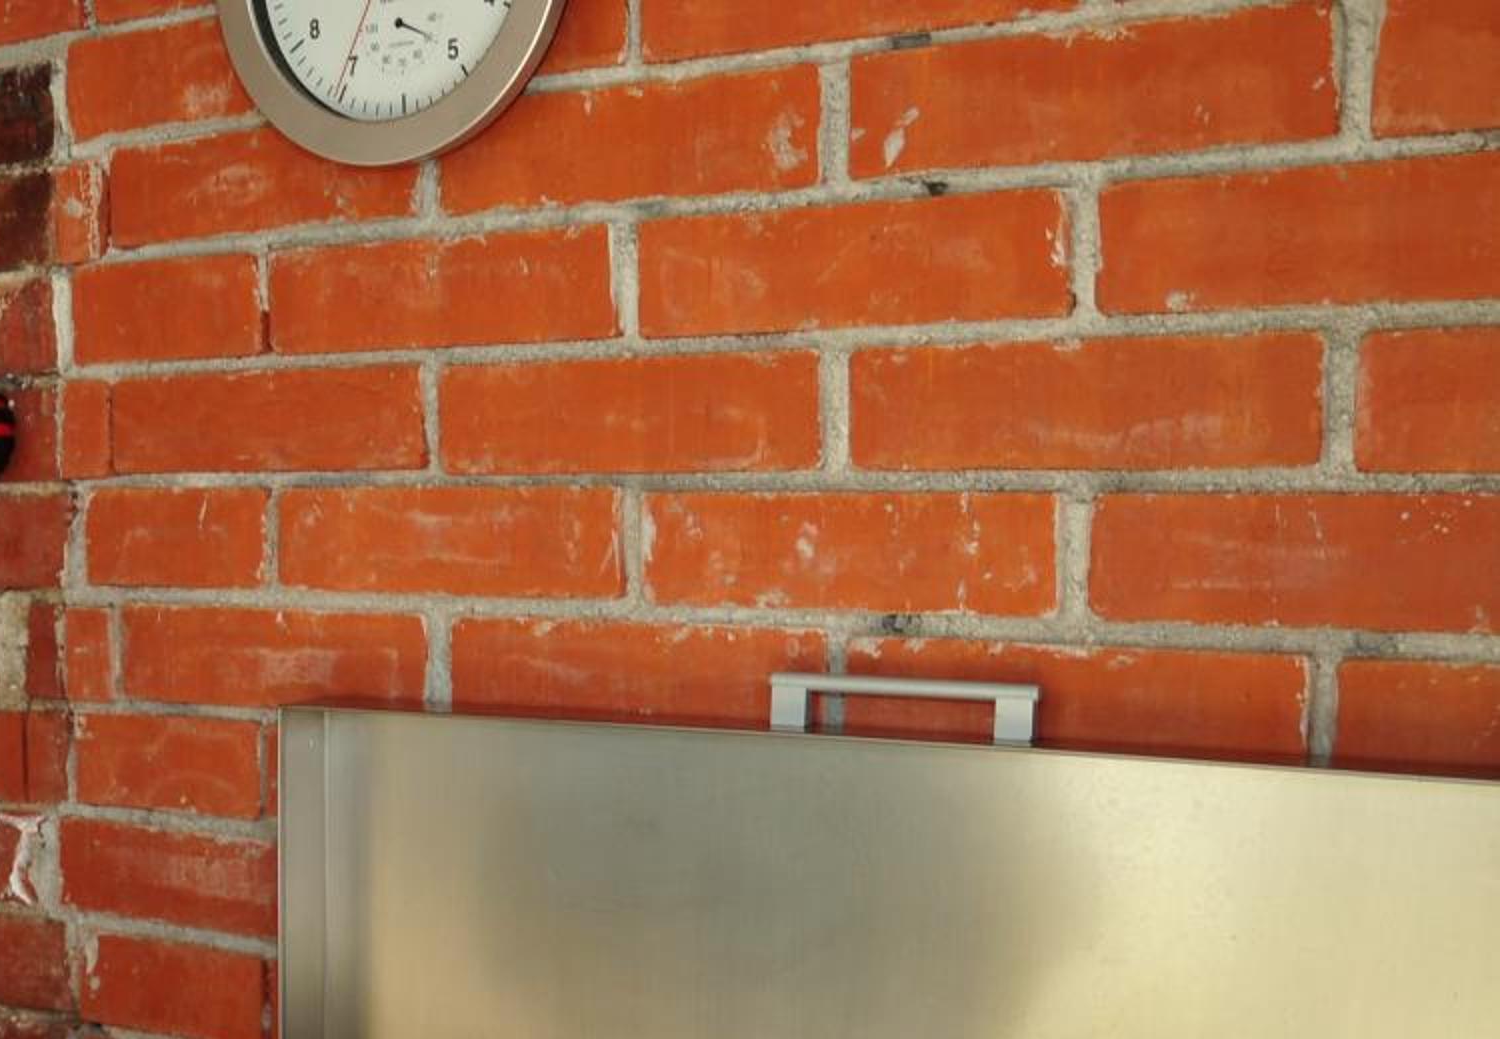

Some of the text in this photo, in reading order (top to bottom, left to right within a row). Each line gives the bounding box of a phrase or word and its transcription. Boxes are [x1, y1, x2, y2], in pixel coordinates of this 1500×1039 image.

[309, 18, 321, 39] 8
[447, 38, 459, 60] 5
[347, 55, 358, 77] 7
